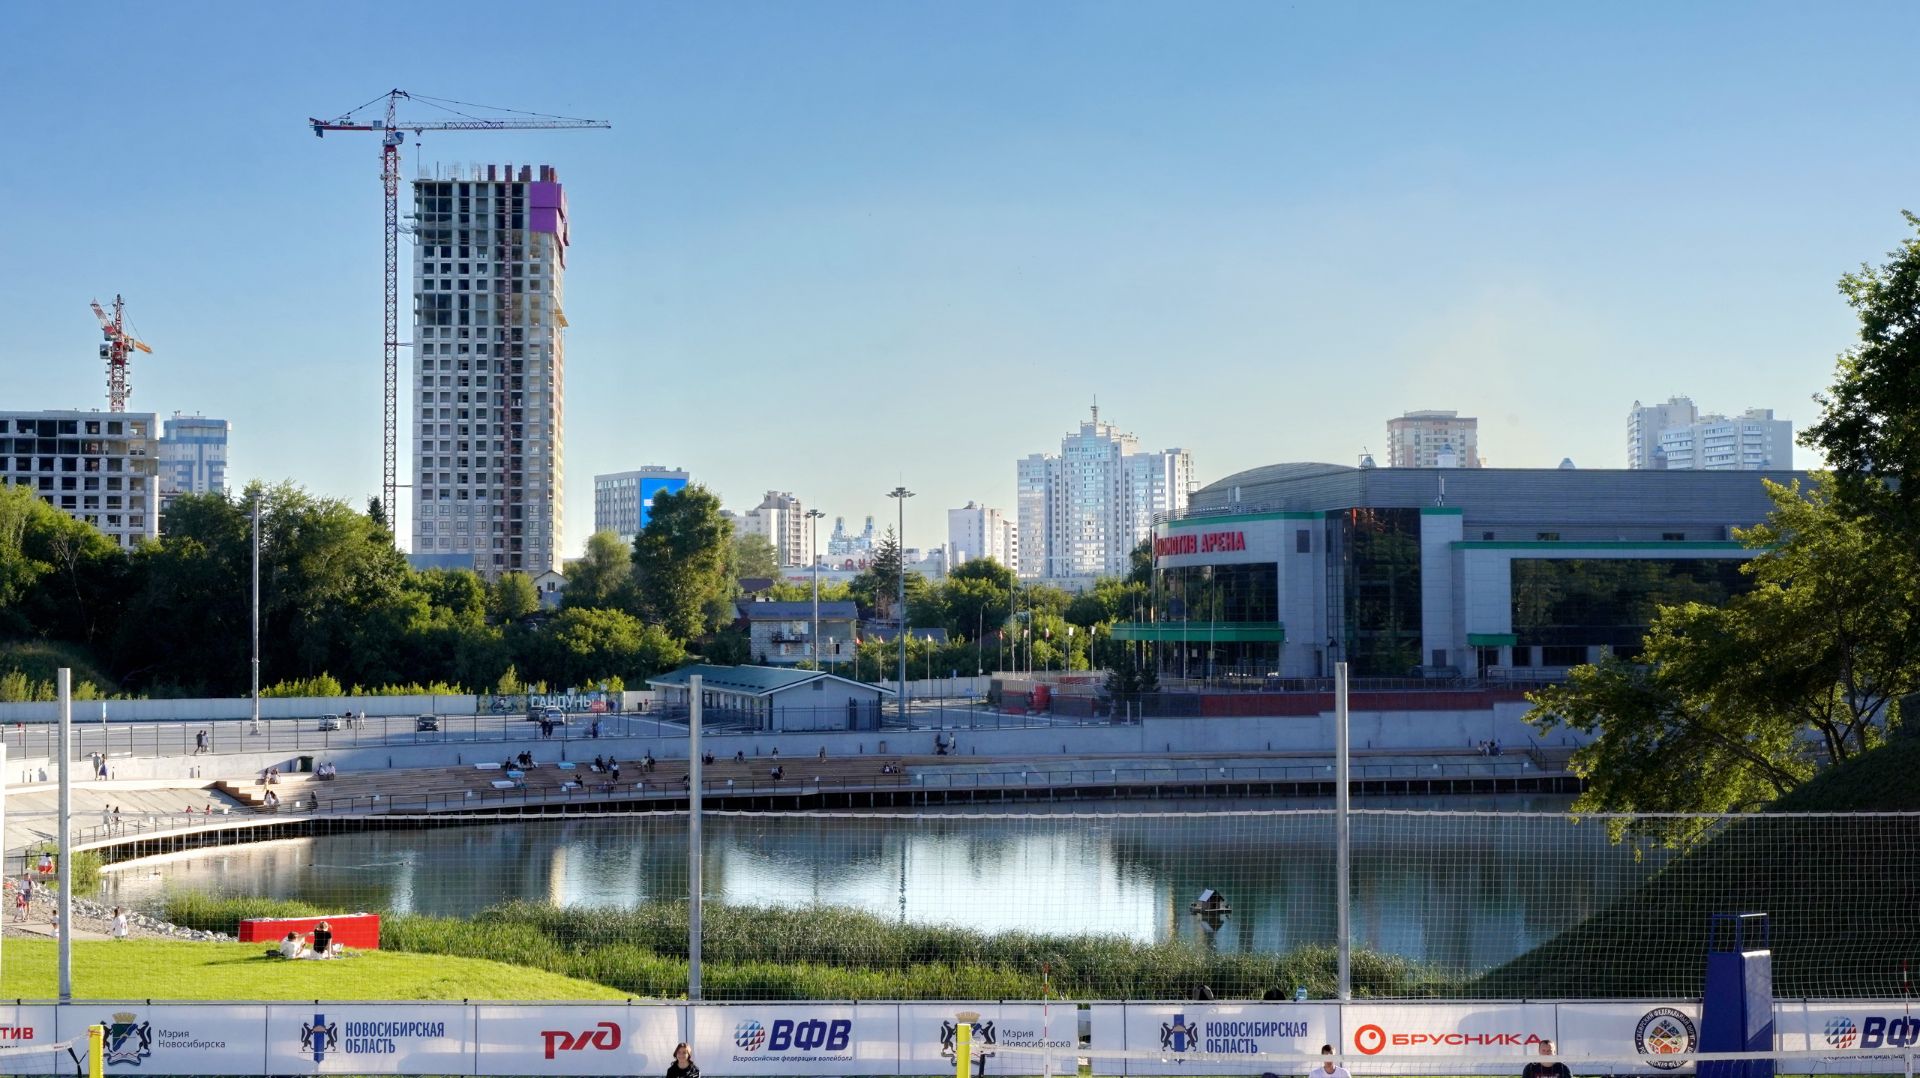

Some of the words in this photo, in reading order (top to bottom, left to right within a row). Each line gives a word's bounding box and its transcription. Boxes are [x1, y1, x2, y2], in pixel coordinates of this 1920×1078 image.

[1201, 532, 1246, 552] АРЕНА
[158, 1029, 190, 1040] Мэрия
[345, 1022, 445, 1037] НОВОСИБИРСКАЯ
[768, 1019, 852, 1051] ВФВ
[1002, 1029, 1034, 1040] Мэрия
[1206, 1022, 1308, 1037] НОВОСИБИРСКАЯ
[158, 1040, 226, 1049] Новосибирска
[345, 1038, 396, 1053] ОБЛАСТЬ
[541, 1022, 621, 1059] РЖД
[1002, 1039, 1071, 1048] Новосибирска
[1206, 1039, 1258, 1053] ОБЛАСТЬ
[1392, 1033, 1542, 1045] БРУСНИКА
